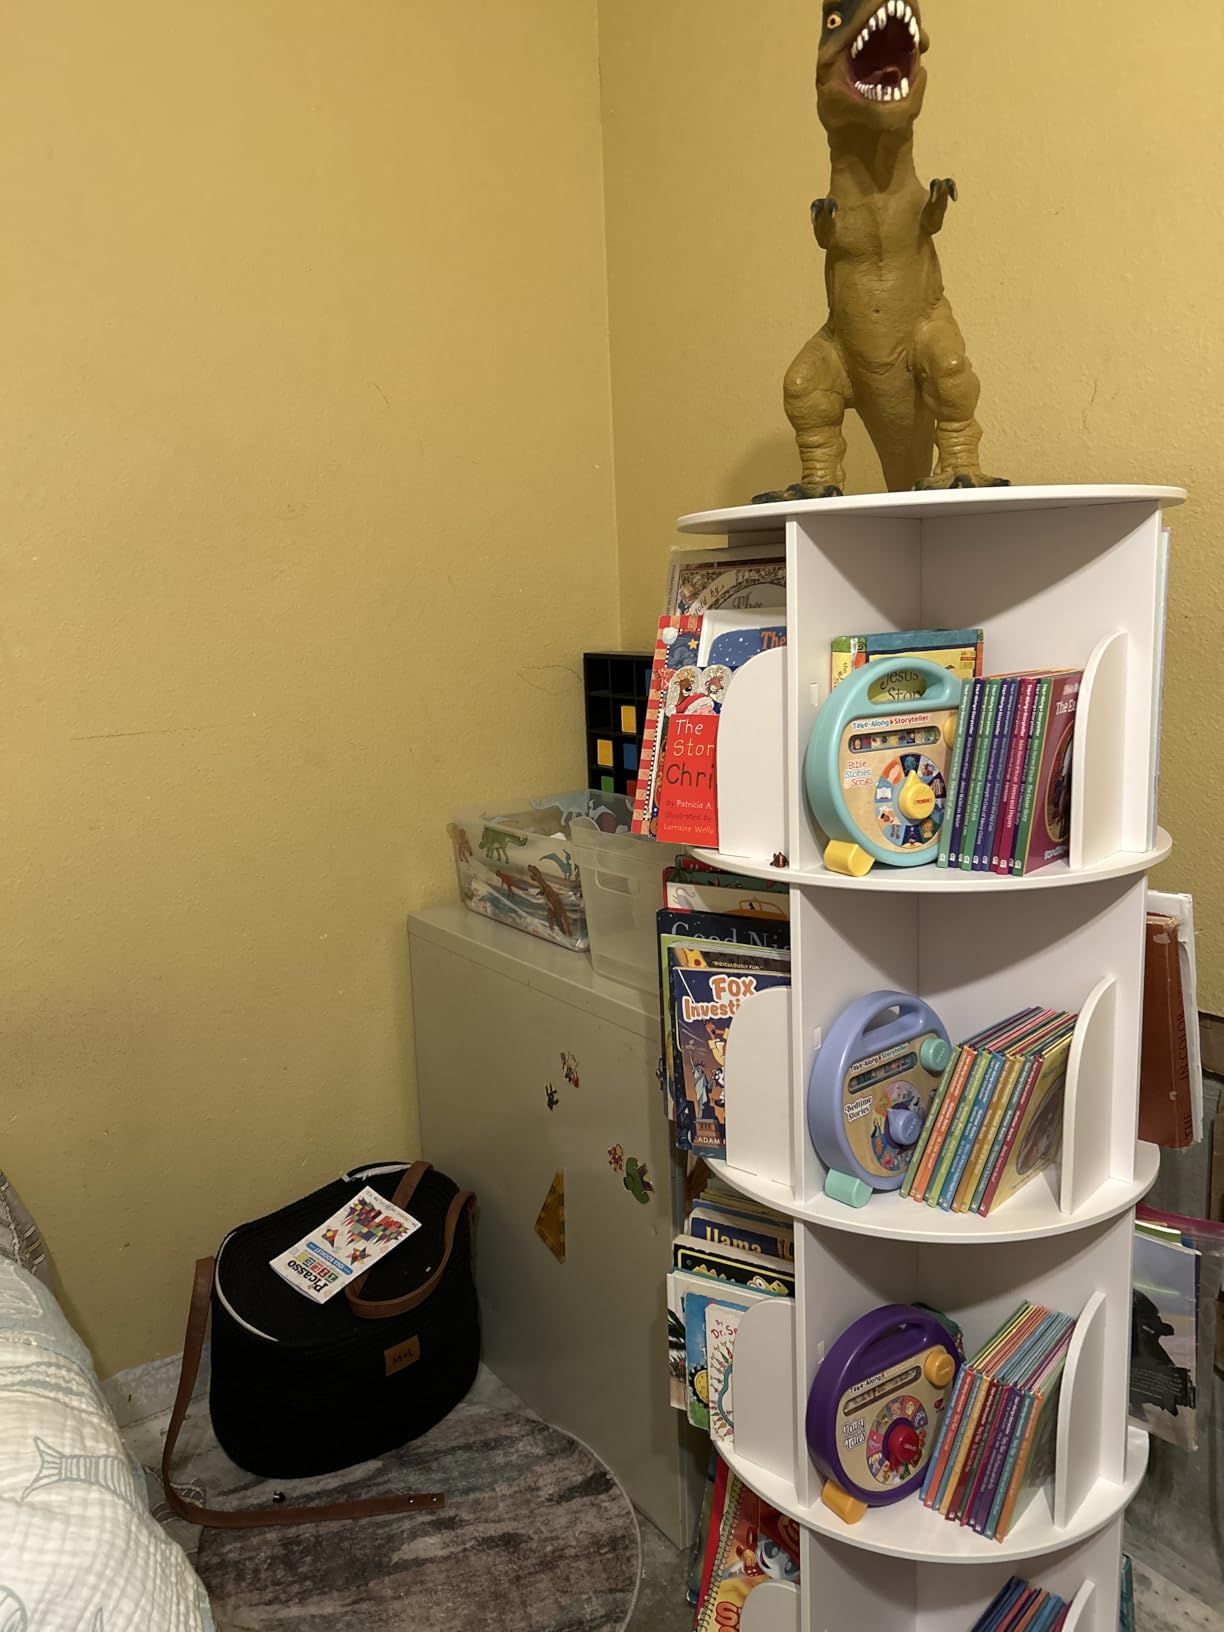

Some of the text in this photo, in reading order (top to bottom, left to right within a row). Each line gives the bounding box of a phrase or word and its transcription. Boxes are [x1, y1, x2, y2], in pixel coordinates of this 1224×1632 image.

[760, 631, 786, 650] The
[880, 671, 919, 690] Jesus
[675, 719, 704, 736] The
[853, 715, 929, 729] Take-Along Storyteller
[673, 739, 715, 757] Stor
[849, 761, 868, 770] Bible
[666, 763, 714, 789] Chri
[845, 769, 872, 779] Stories
[676, 799, 703, 809] Patricia
[664, 824, 692, 832] Lorraine
[844, 1097, 873, 1112] Bedtime
[698, 1136, 720, 1145] ADAM
[313, 1246, 335, 1262] BOOKLET
[288, 1260, 328, 1293] Picasso
